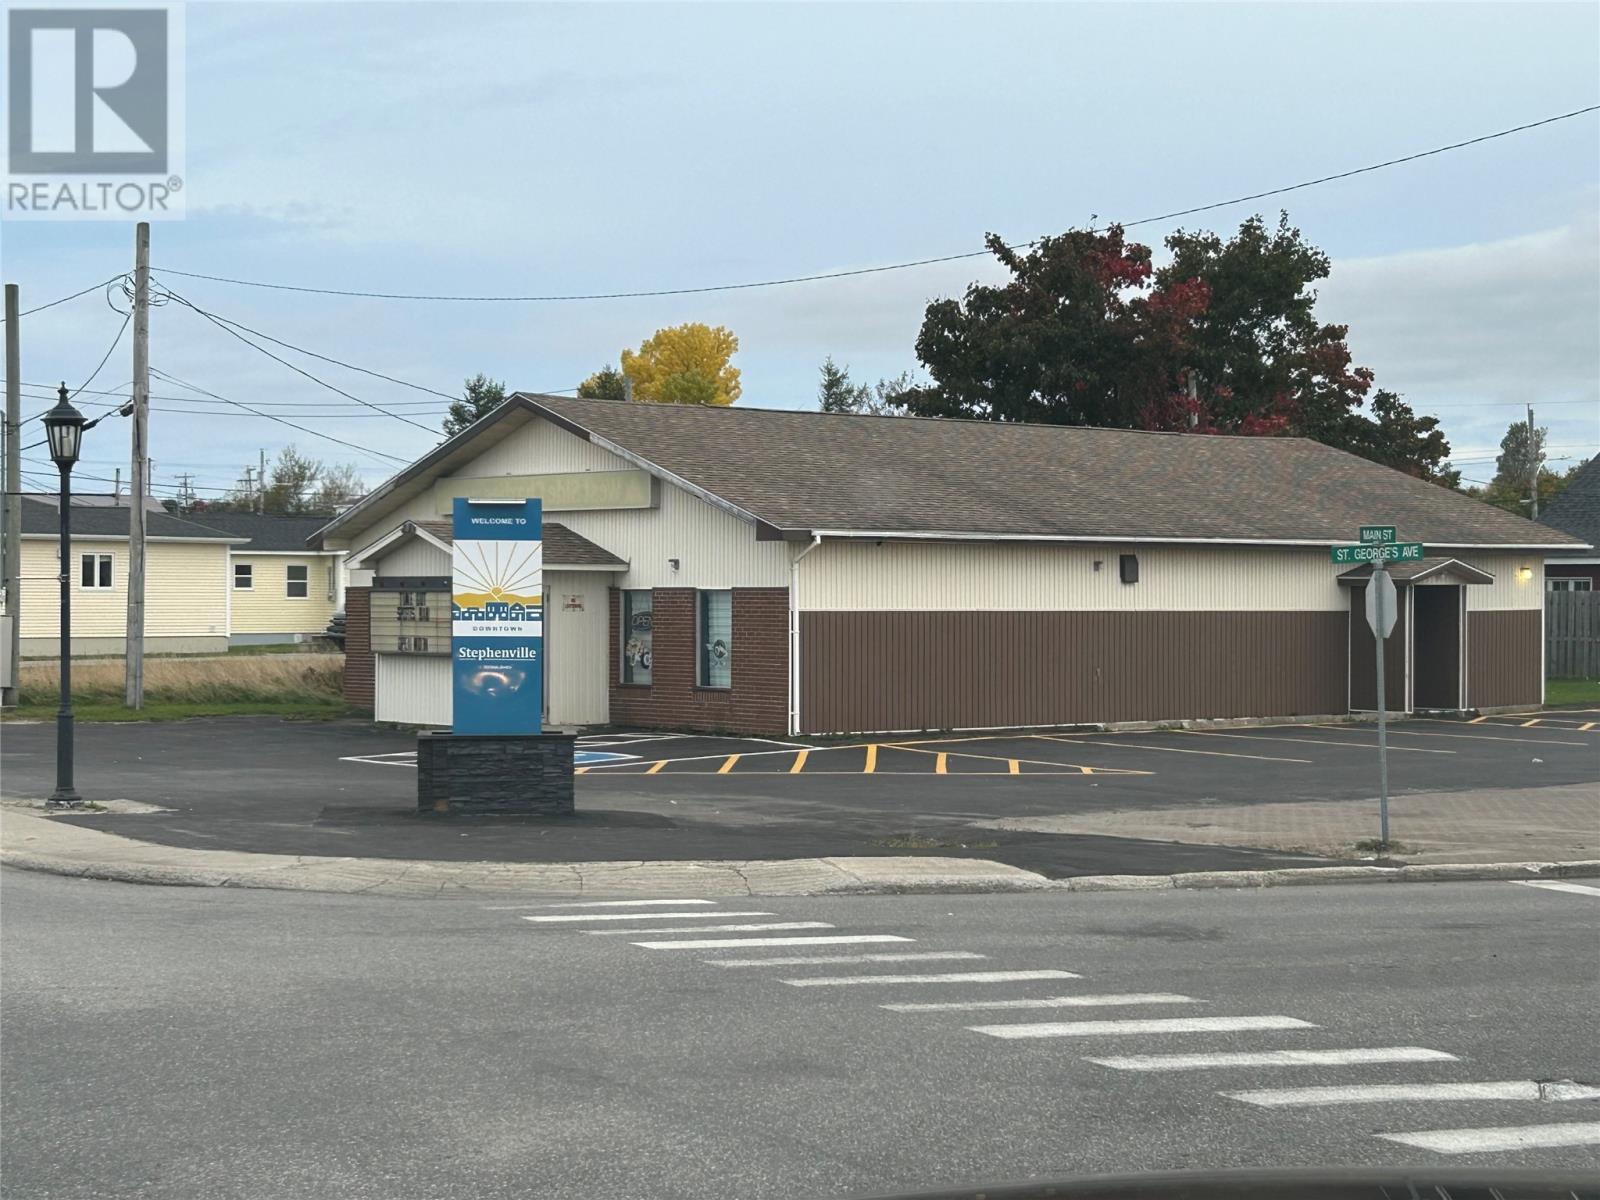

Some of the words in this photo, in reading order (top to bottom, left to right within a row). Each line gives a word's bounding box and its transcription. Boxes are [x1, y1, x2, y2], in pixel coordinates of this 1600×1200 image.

[1363, 530, 1381, 540] MAIN
[1382, 529, 1393, 540] ST
[1337, 549, 1350, 560] ST.
[1354, 547, 1398, 560] GEORGE'S
[1402, 546, 1419, 558] AVE
[459, 647, 537, 661] Stephenville
